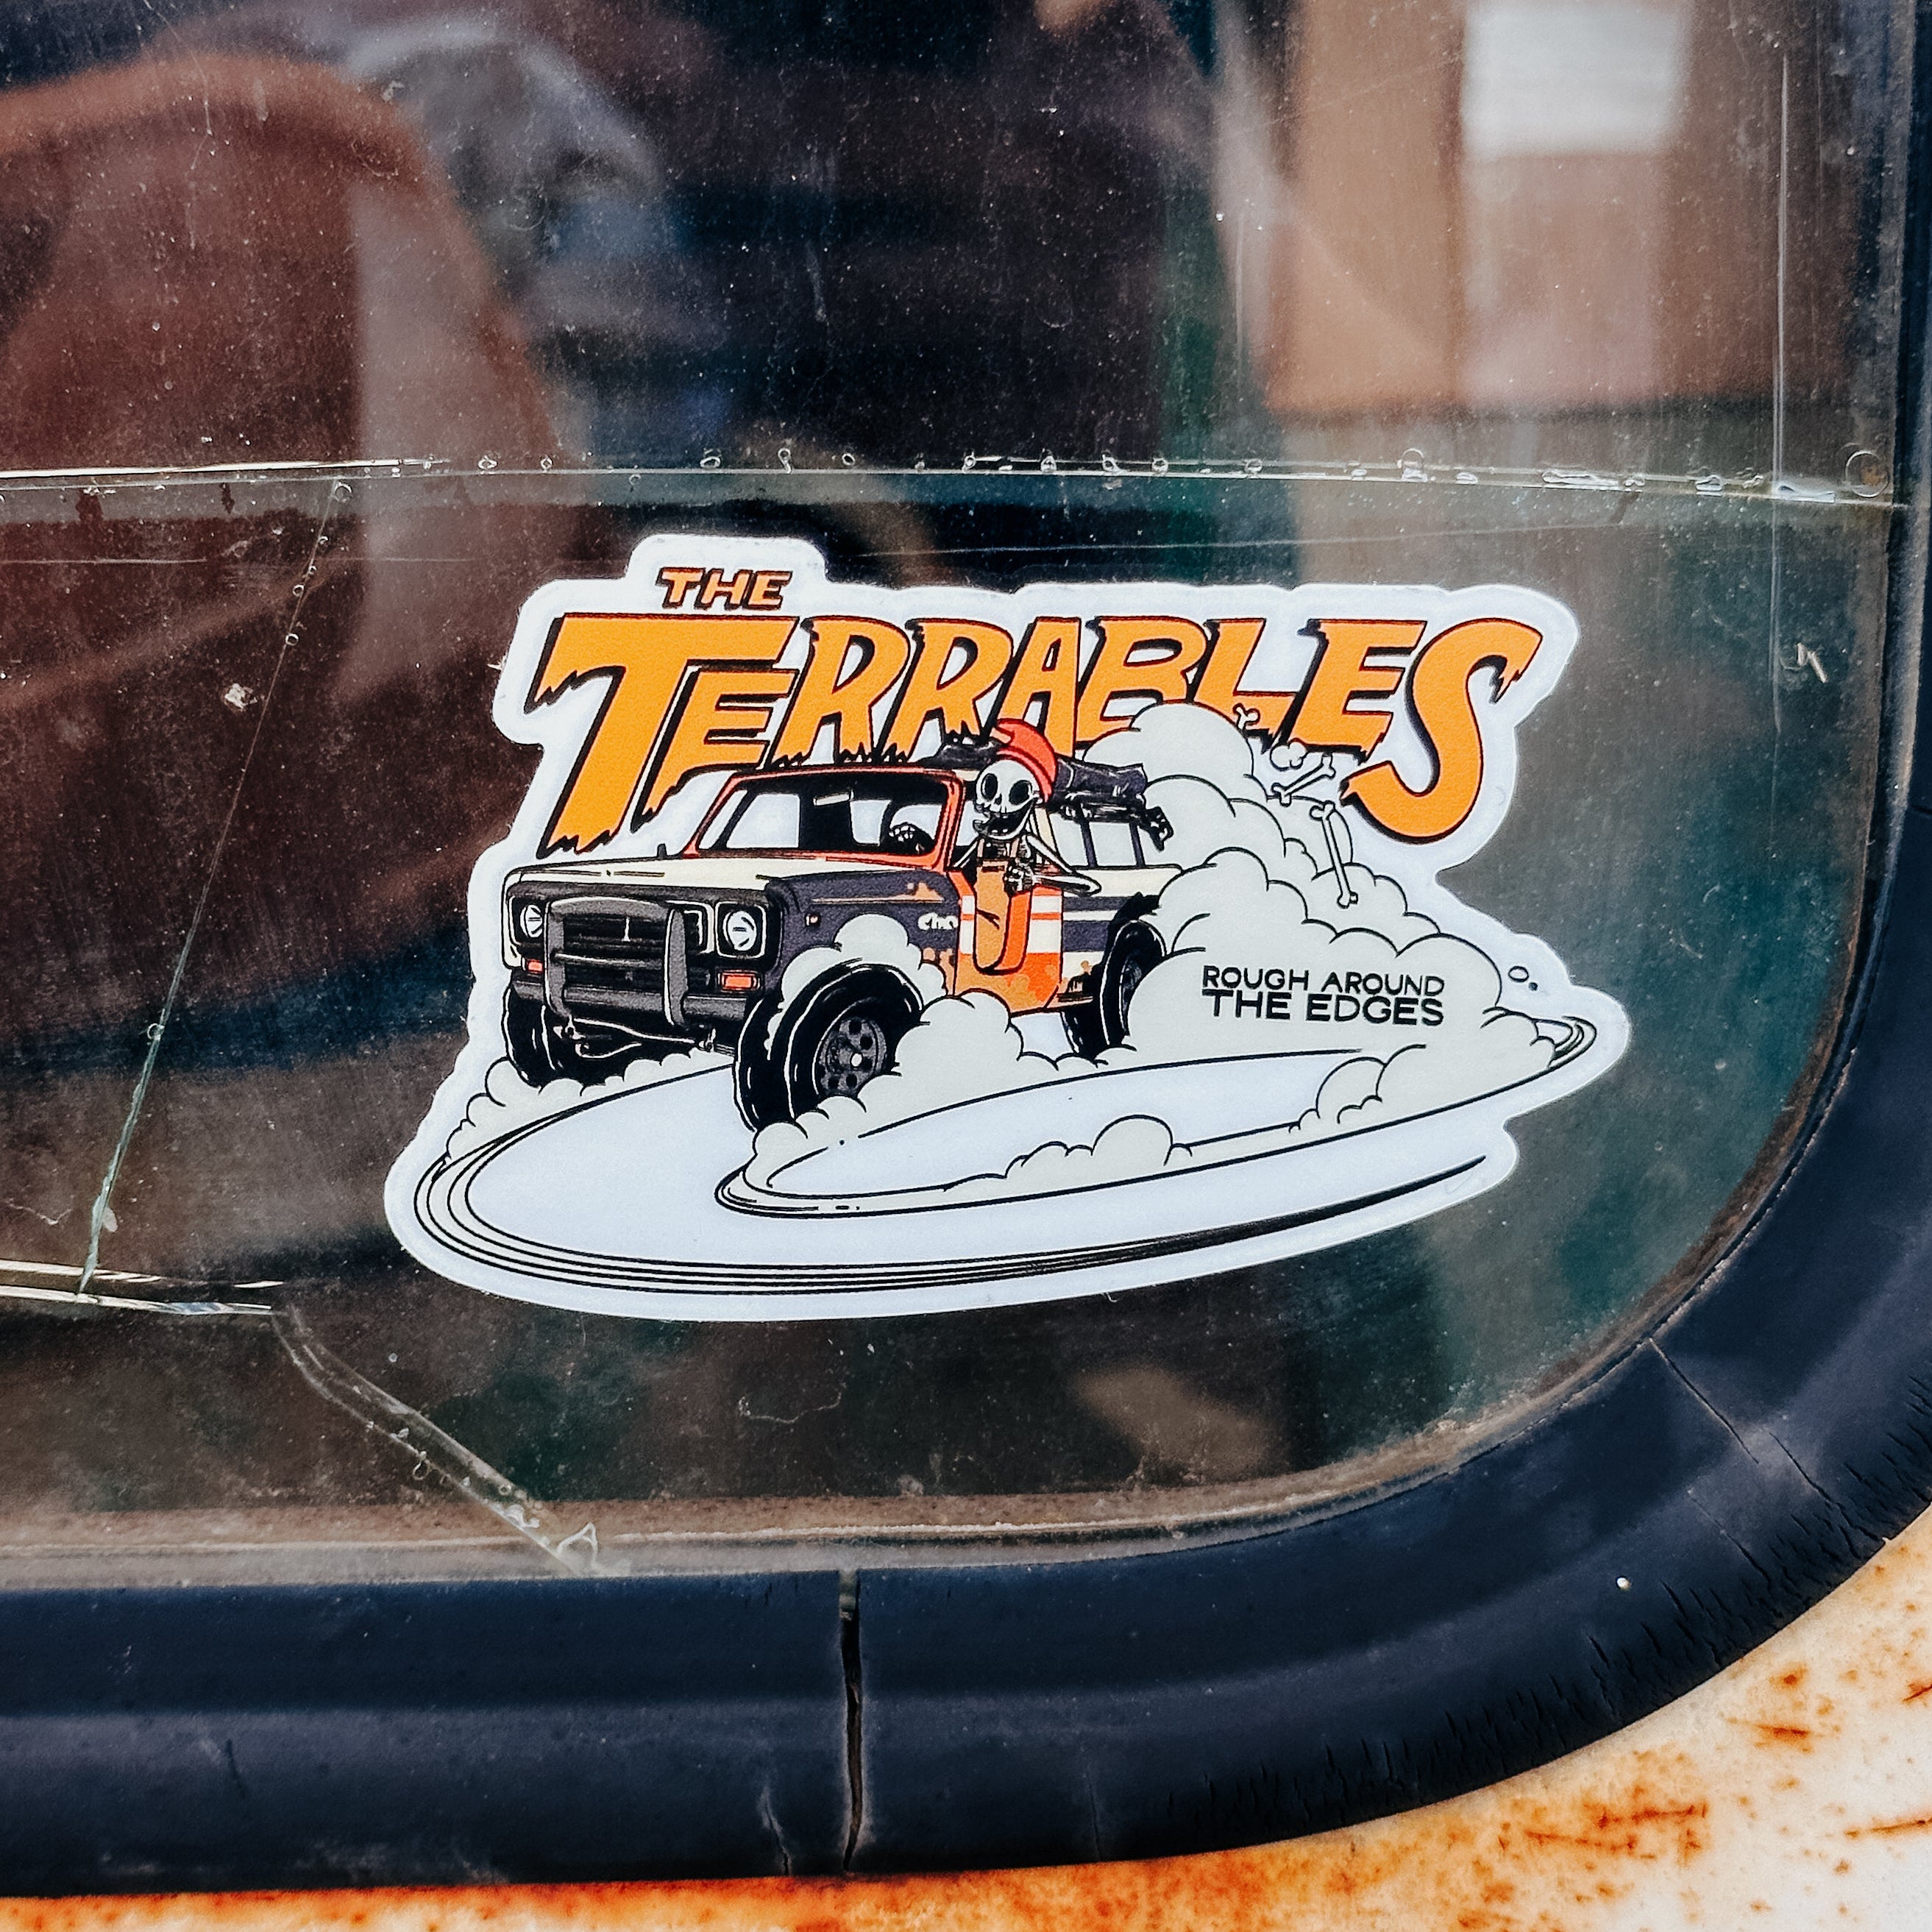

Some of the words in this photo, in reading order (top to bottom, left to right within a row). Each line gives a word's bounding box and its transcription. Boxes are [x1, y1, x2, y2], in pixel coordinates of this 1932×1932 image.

[656, 567, 793, 611] THE
[524, 612, 1544, 859] TERRABLES
[1203, 965, 1309, 991] ROUGH
[1321, 971, 1445, 995] AROUND
[1202, 989, 1292, 1020] THE
[1305, 993, 1444, 1026] EDGES
